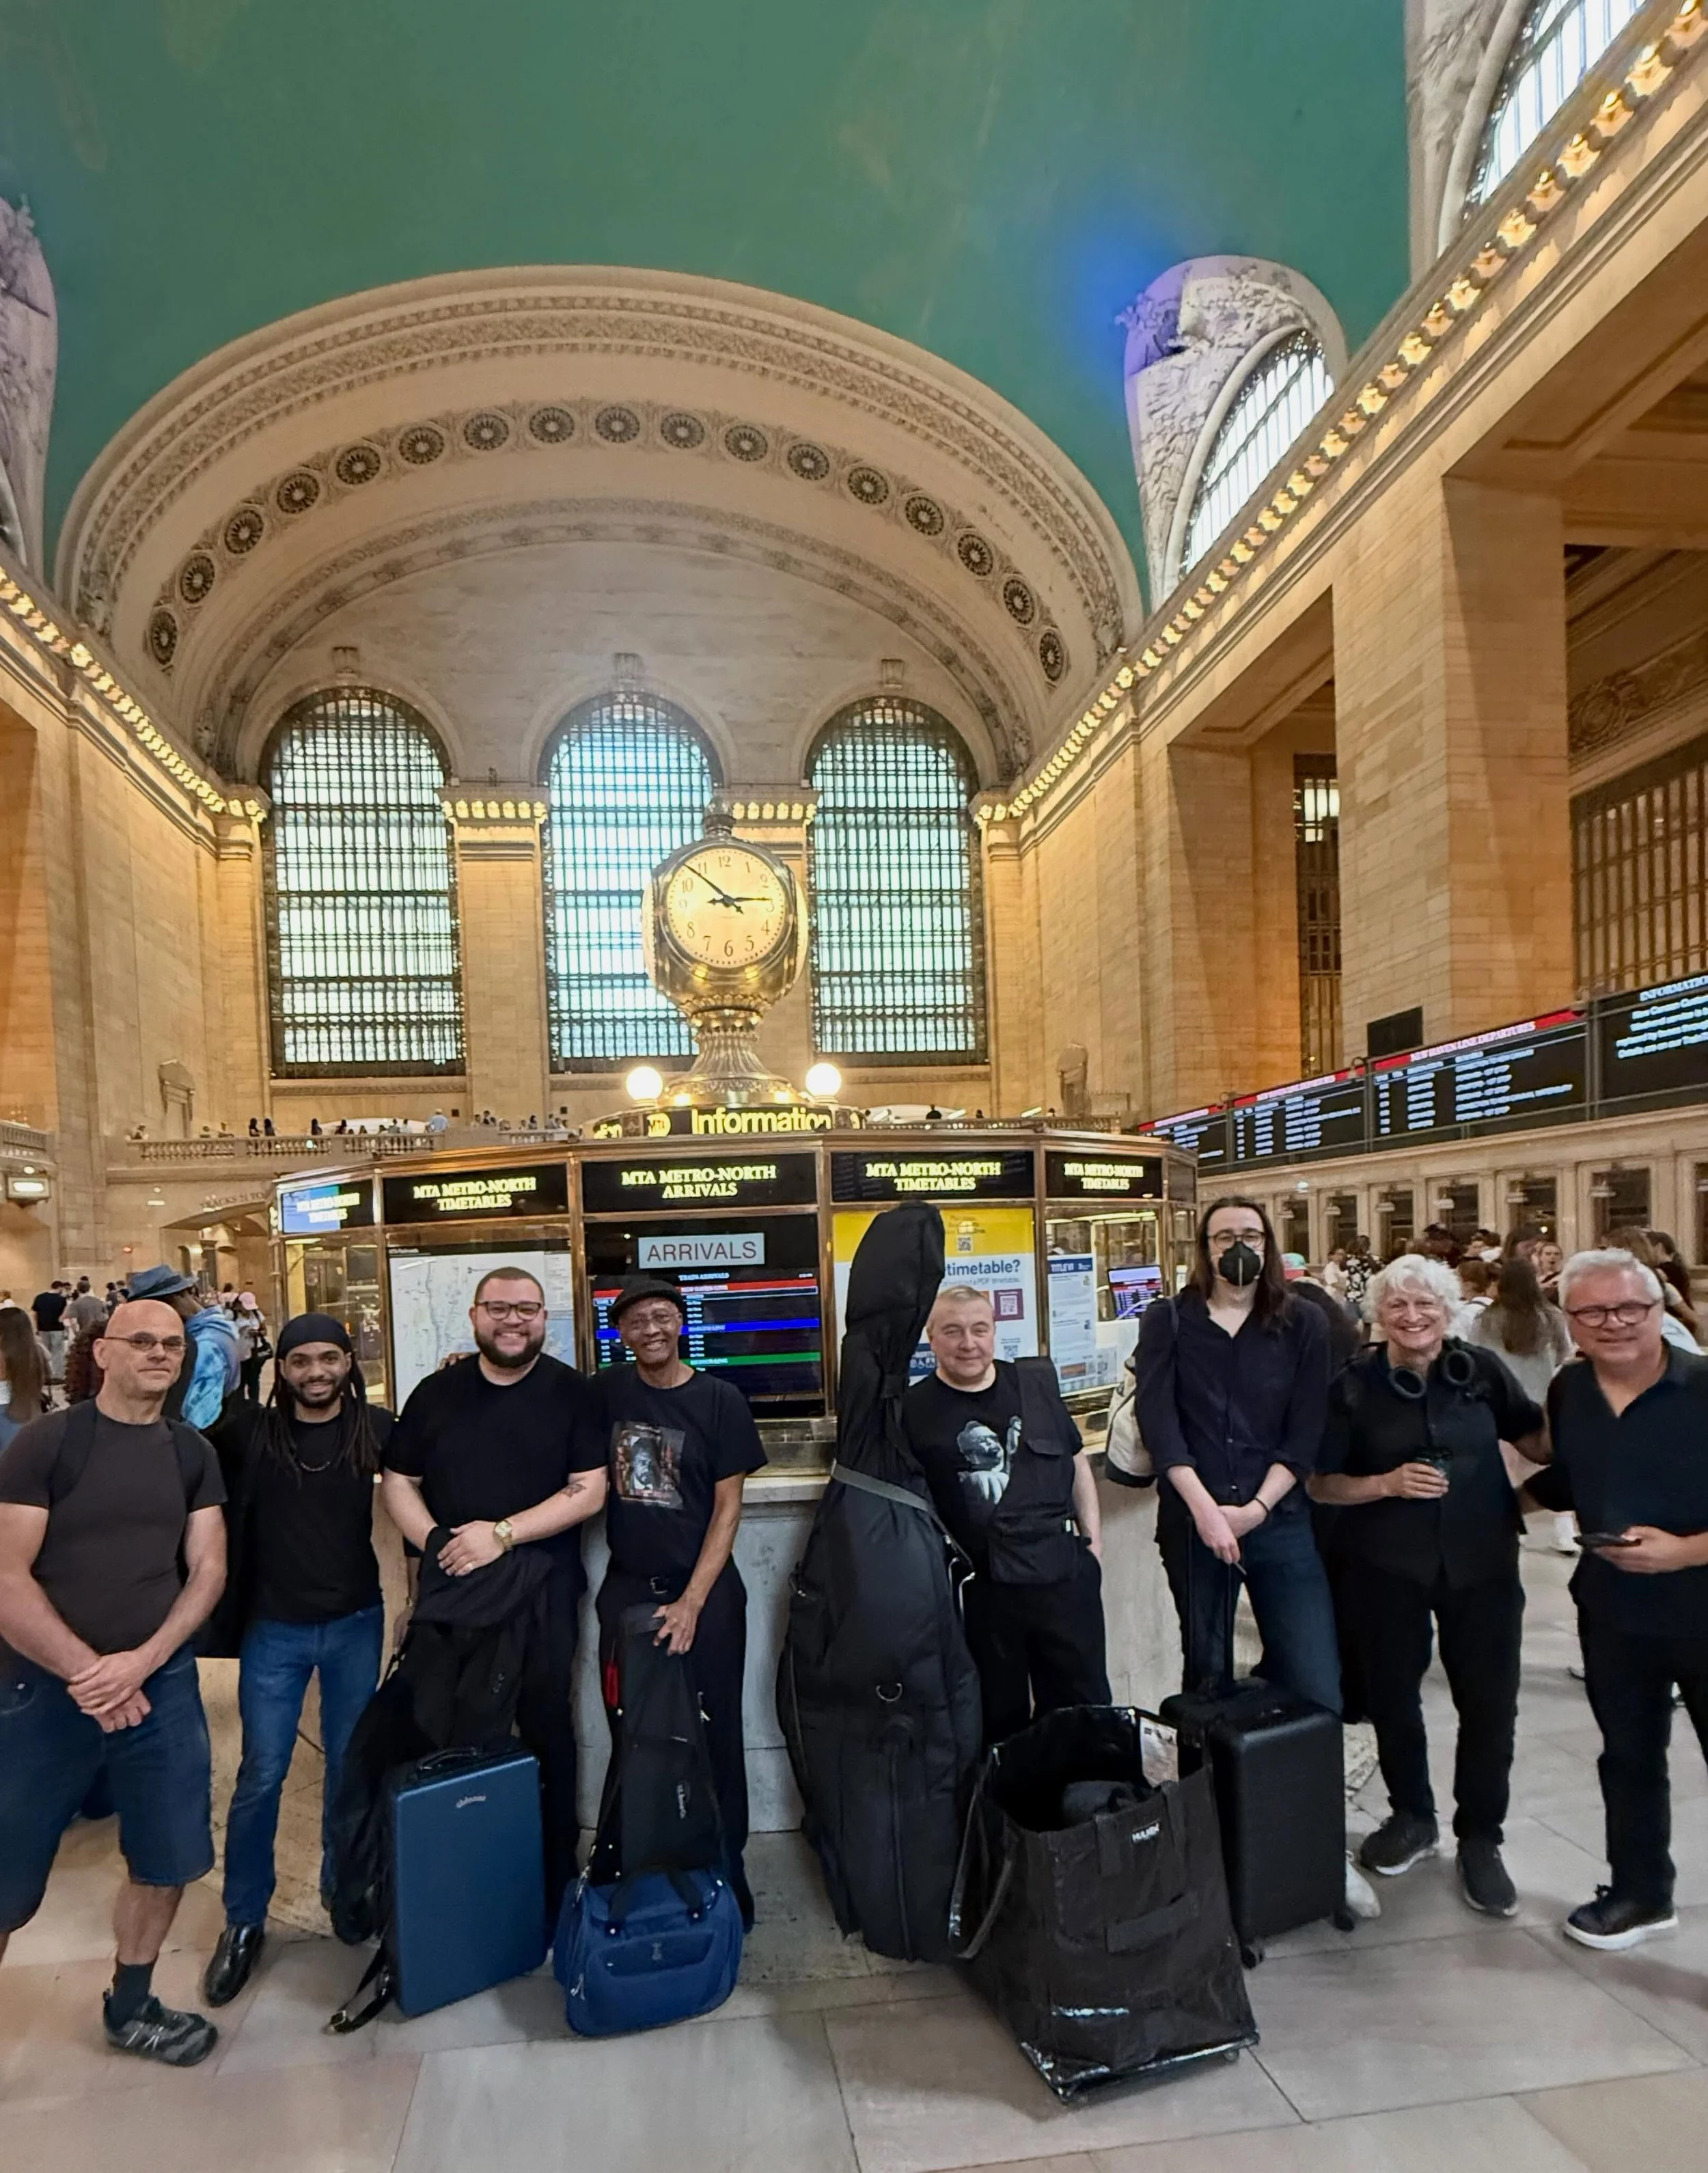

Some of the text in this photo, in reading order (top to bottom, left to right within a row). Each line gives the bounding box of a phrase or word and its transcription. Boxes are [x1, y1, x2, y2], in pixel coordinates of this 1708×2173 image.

[698, 862, 708, 875] 11
[718, 856, 732, 868] 12
[745, 861, 751, 874] 1
[681, 877, 693, 894] 10
[760, 874, 769, 888] 2
[679, 899, 688, 910] 9
[765, 899, 775, 913] 3
[687, 921, 695, 939] 8
[760, 919, 770, 935] 4
[702, 935, 711, 952] 7
[724, 940, 734, 957] 6
[745, 935, 754, 952] 5
[691, 1107, 831, 1135] Information
[622, 1165, 777, 1186] MTA METRO-NORTH
[866, 1162, 1001, 1177] MTA METRO-NORTH
[413, 1177, 536, 1199] MTA METRO-NORTH
[662, 1183, 738, 1198] ARRIVALS
[894, 1177, 976, 1191] TIMETABLES
[437, 1194, 512, 1211] TIMETABLES
[647, 1241, 757, 1262] ARRIVALS
[947, 1259, 1021, 1276] timetable?
